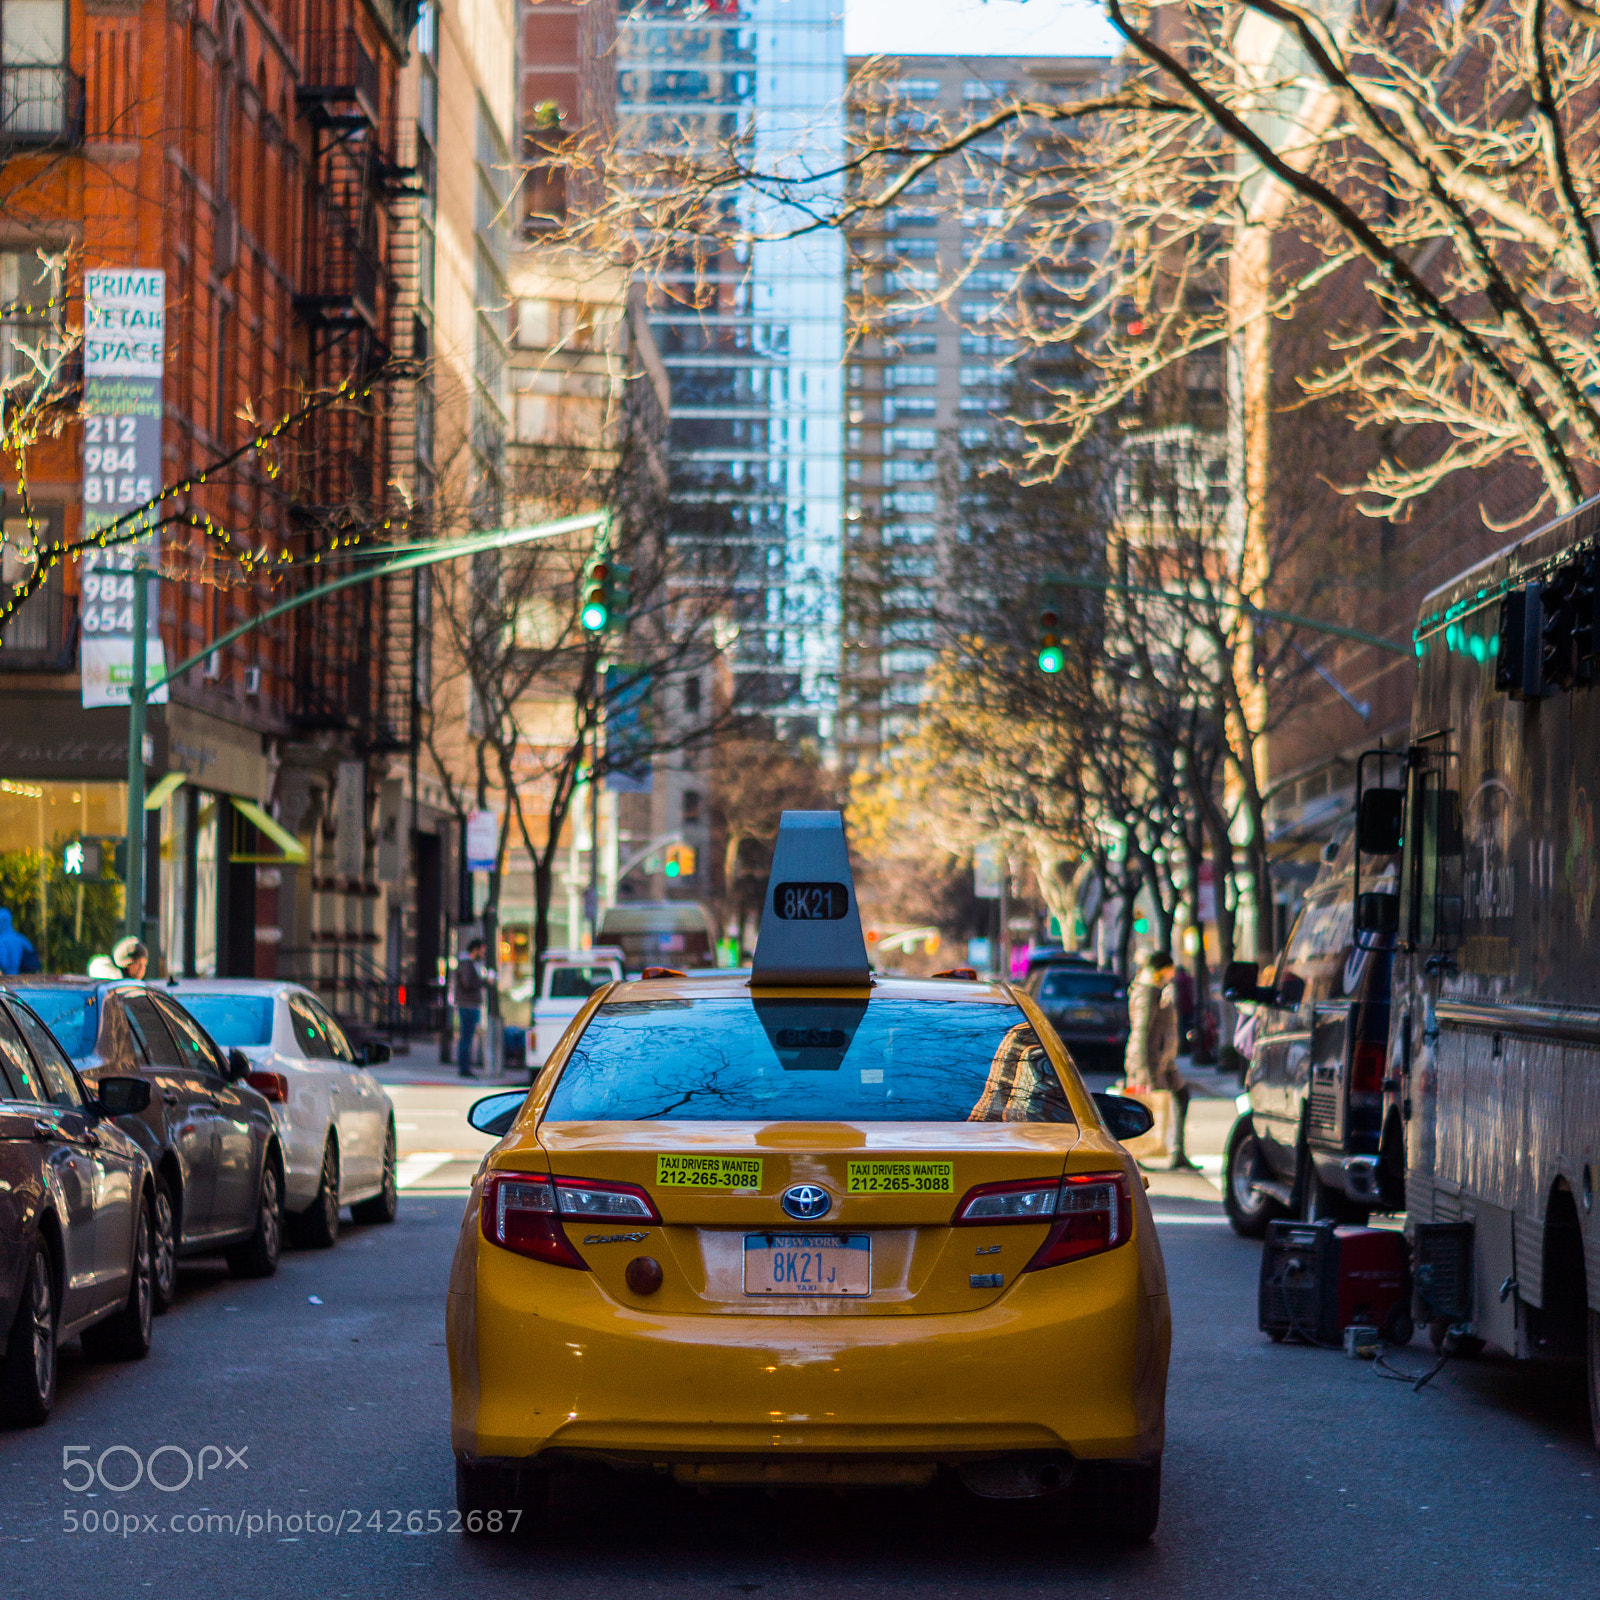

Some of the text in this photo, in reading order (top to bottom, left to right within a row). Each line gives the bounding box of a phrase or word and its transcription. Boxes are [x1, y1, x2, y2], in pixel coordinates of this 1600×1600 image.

[89, 275, 161, 297] PRIME
[88, 341, 162, 363] SPACE
[87, 381, 154, 399] Andrew
[85, 416, 136, 443] 212
[85, 446, 136, 473] 984
[84, 476, 153, 504] 8155
[84, 575, 135, 602] 984
[784, 888, 833, 919] 8K21
[660, 1157, 759, 1173] TAXI DRIVERS WANTED
[850, 1165, 950, 1176] TAXI DRIVERS WANTED
[660, 1170, 758, 1188] 212-265-3088
[851, 1177, 949, 1191] 212-265-3088
[775, 1237, 839, 1247] NEW YORK
